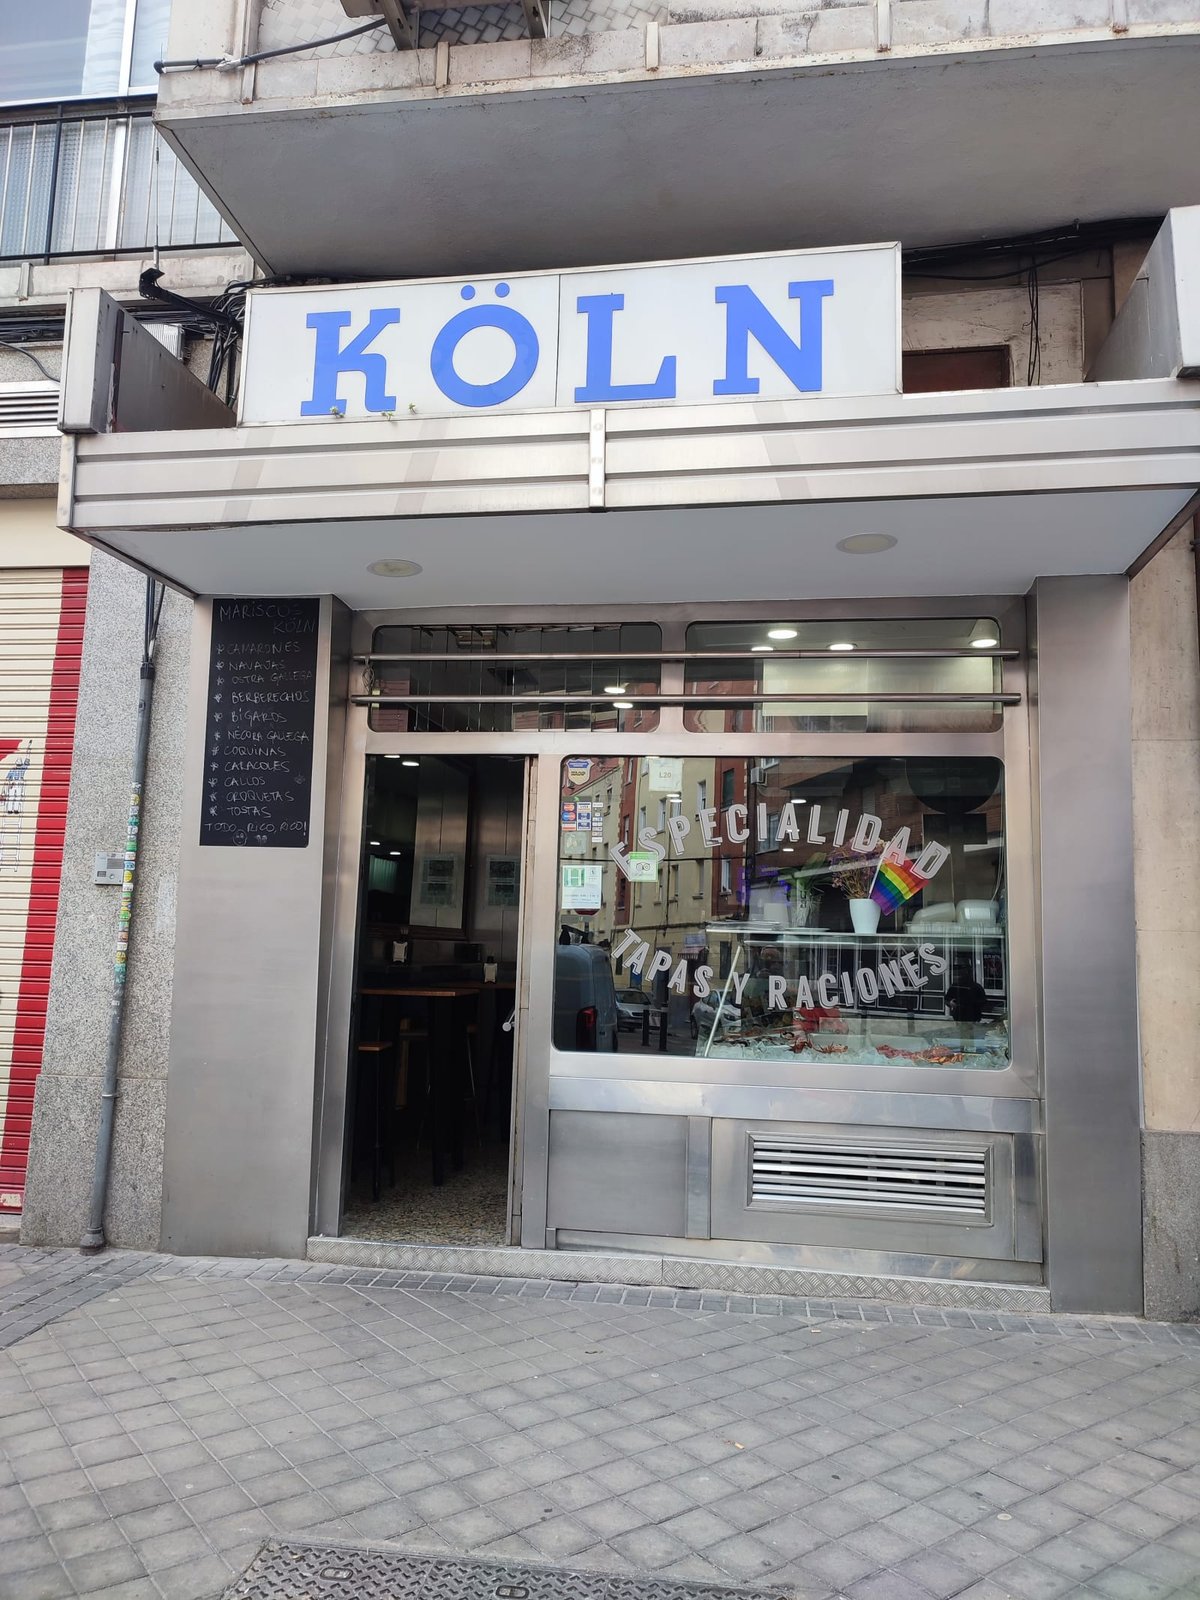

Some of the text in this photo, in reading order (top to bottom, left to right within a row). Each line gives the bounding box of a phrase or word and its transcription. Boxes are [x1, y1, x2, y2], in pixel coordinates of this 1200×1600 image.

[301, 279, 834, 416] KÖLN
[231, 690, 310, 704] BERBERECHOS
[224, 744, 286, 757] COQUINAS
[224, 776, 266, 787] CALLOS
[226, 790, 294, 802] CROQUETAS
[227, 805, 271, 818] TOSTAS
[204, 822, 237, 832] TODO
[609, 802, 951, 882] ESPECIALIDAD
[611, 928, 948, 1012] TAPAS Y RACIONES
